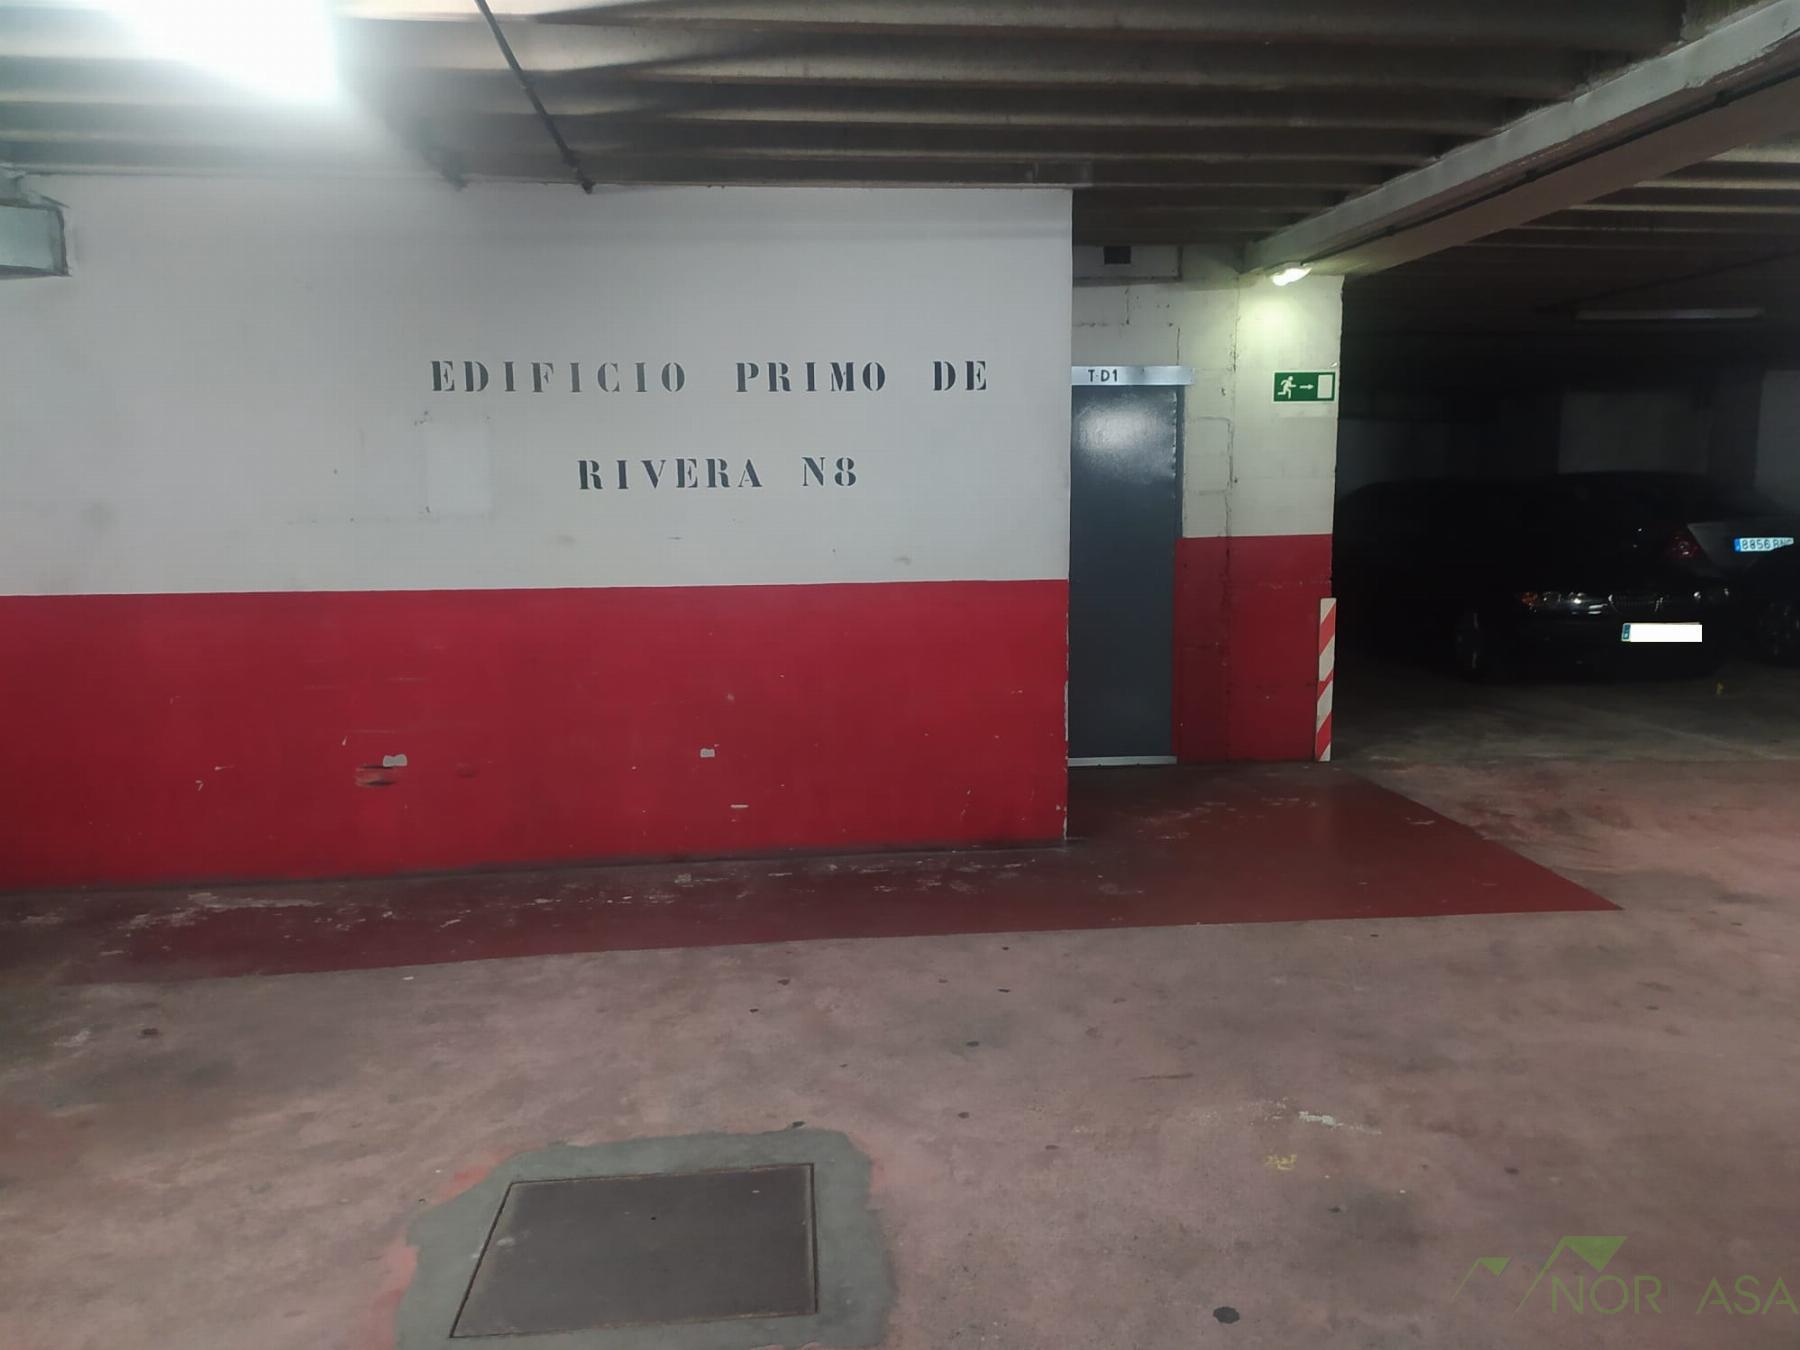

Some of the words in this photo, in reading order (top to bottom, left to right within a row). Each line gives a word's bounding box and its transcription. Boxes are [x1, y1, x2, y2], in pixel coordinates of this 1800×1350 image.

[431, 360, 686, 393] EDIFICIO
[735, 361, 886, 392] PRIMO
[932, 360, 987, 391] DE
[577, 458, 763, 490] RIVERA
[802, 456, 857, 487] N8
